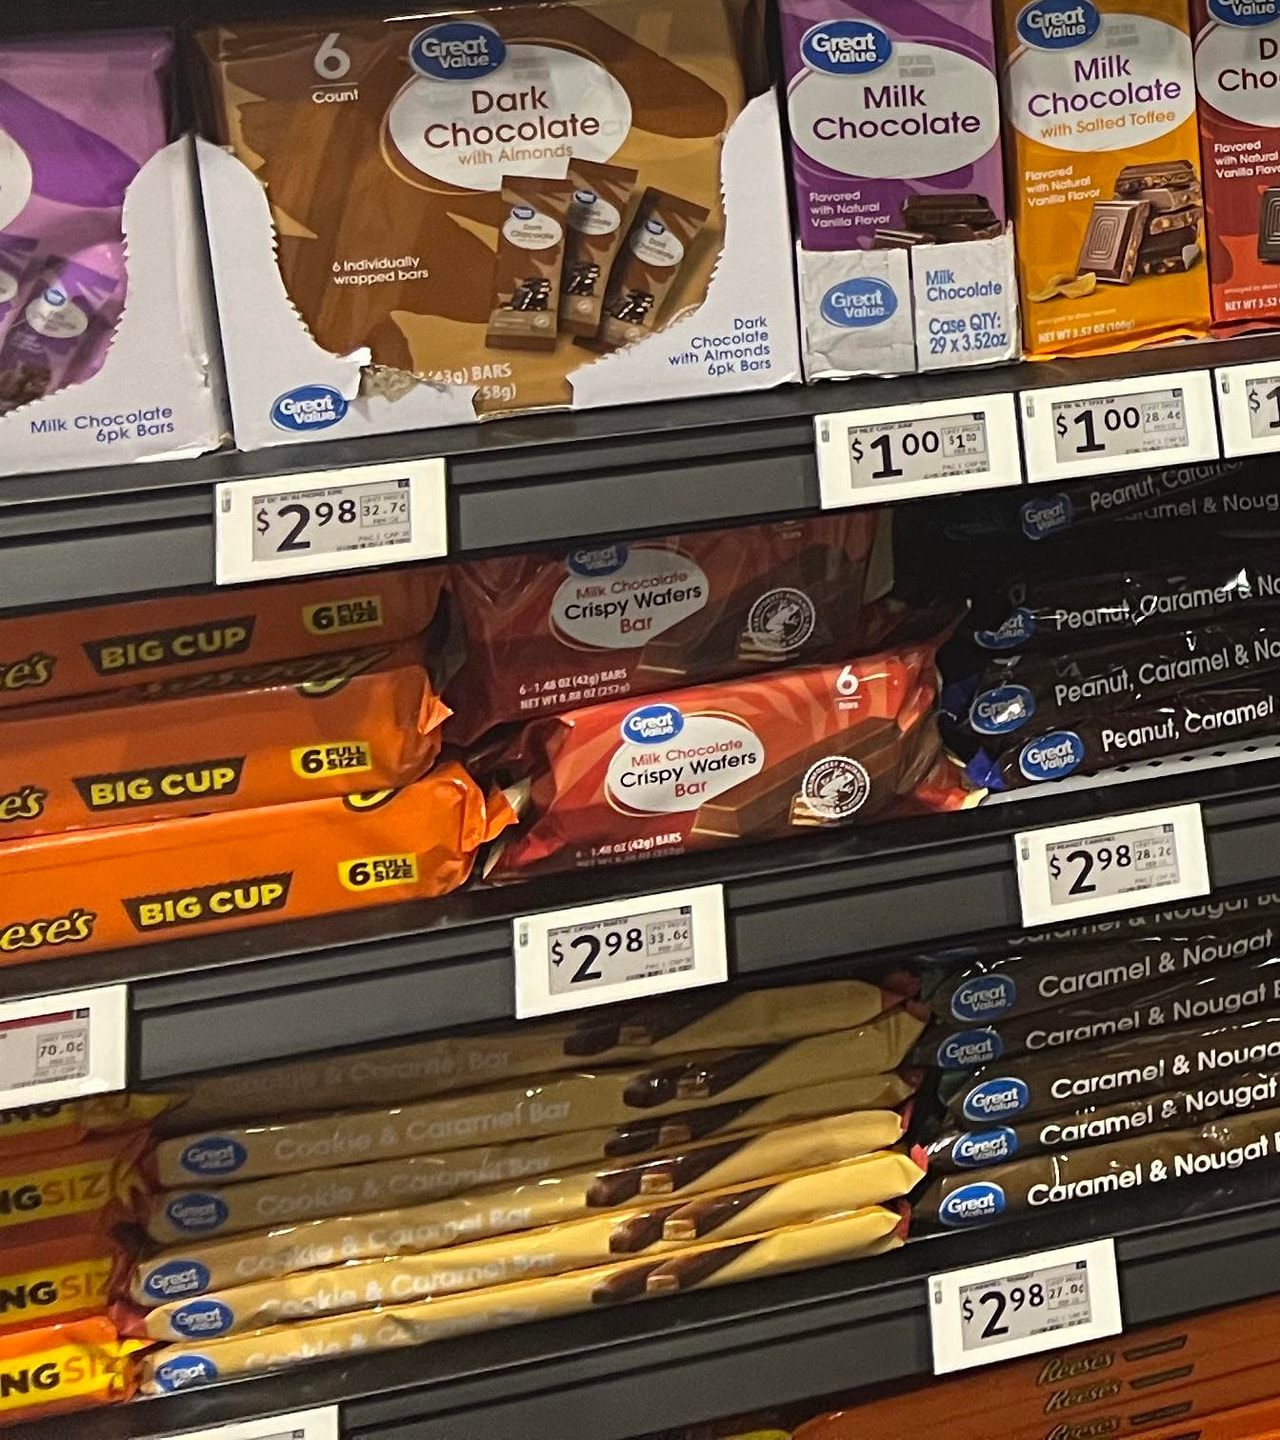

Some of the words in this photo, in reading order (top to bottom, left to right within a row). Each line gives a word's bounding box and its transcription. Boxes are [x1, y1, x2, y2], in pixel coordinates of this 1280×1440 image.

[812, 33, 876, 53] Great
[314, 33, 350, 80] 6
[828, 48, 877, 64] Value
[312, 88, 359, 104] Count
[471, 86, 548, 115] Dark
[863, 85, 925, 109] Milk
[1028, 78, 1181, 118] Chocolate
[424, 113, 600, 149] Chocolate
[1040, 122, 1072, 139] with
[1077, 115, 1126, 136] Salted
[1130, 110, 1176, 127] Toffee
[458, 151, 493, 167] with
[498, 143, 572, 163] Almonds
[1215, 140, 1261, 154] Flavored
[1215, 153, 1238, 166] with
[1240, 151, 1278, 164] Natural
[1215, 166, 1253, 179] Vanilla
[333, 270, 393, 287] wrapped
[398, 266, 428, 281] bars
[733, 316, 767, 332] Dark
[928, 318, 966, 337] Case
[691, 329, 768, 349] Chocolate
[30, 415, 68, 434] Milk
[74, 406, 173, 430] Chocolate
[96, 427, 131, 445] 6pk
[136, 420, 174, 438] Bars
[1102, 718, 1180, 751] Peanut,
[1185, 698, 1273, 732] Caramel
[301, 750, 322, 773] 6
[326, 746, 364, 758] FULL
[326, 756, 368, 771] SIZE
[631, 755, 661, 768] Milk
[666, 740, 742, 760] Chocolate
[620, 768, 684, 788] Crispy
[690, 751, 756, 774] Wafers
[90, 778, 153, 806] BIG
[161, 767, 235, 797] CUP
[674, 780, 707, 798] Bar
[139, 897, 200, 926] BIG
[209, 884, 283, 912] CUP
[1028, 1169, 1142, 1206] Caramel
[1149, 1160, 1167, 1182] &
[1175, 1139, 1268, 1176] Nougat
